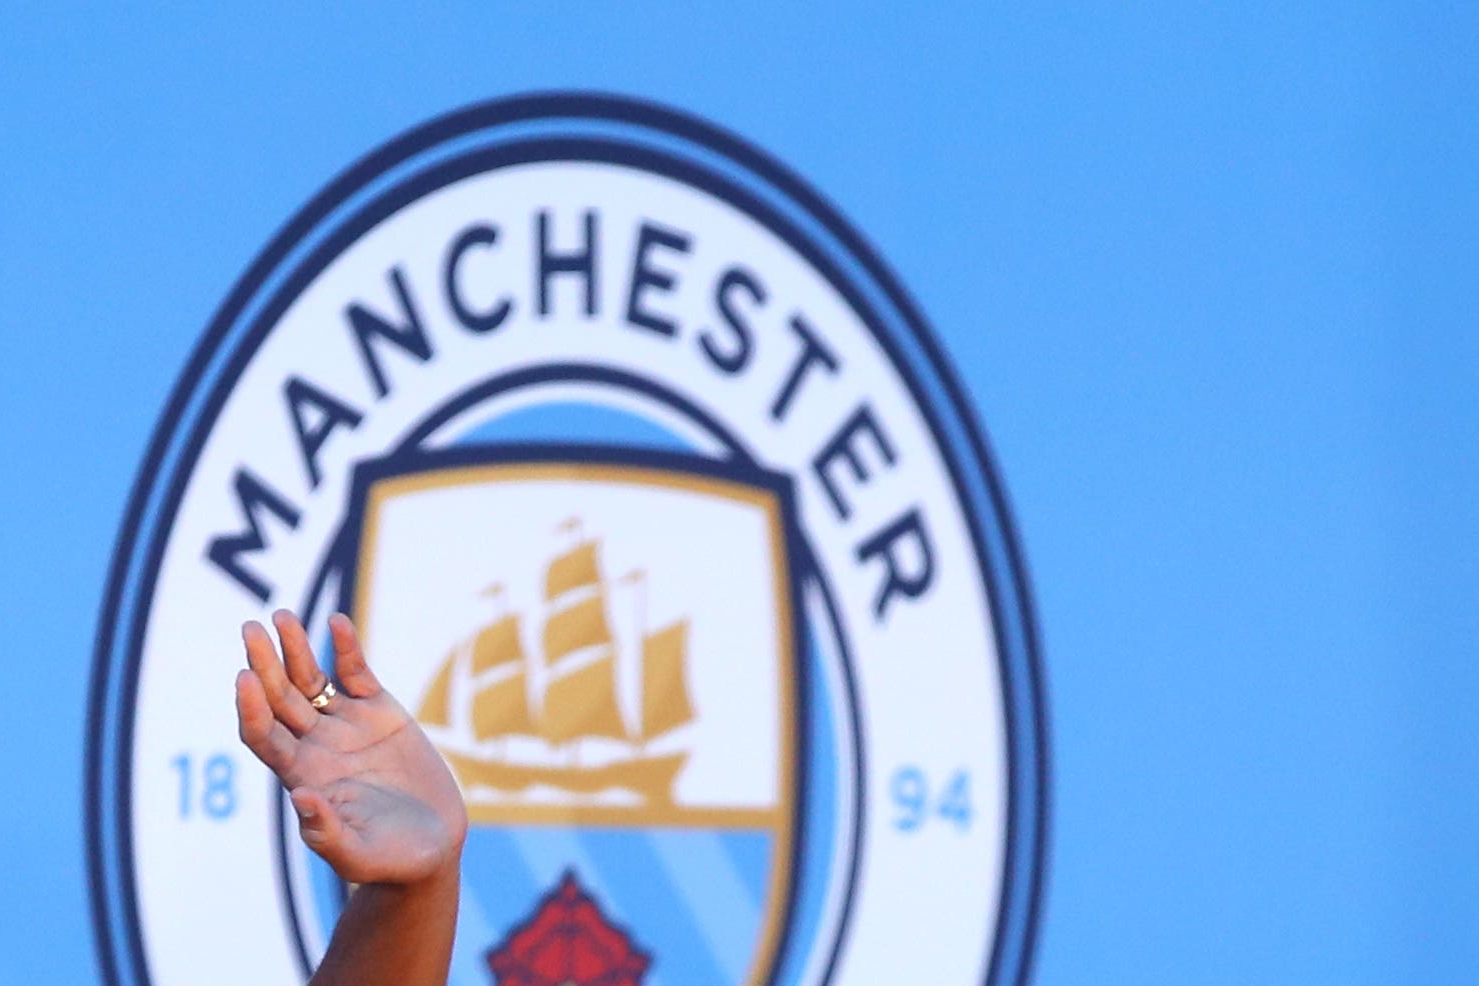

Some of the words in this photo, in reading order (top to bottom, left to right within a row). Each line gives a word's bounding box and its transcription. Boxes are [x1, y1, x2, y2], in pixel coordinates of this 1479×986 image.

[204, 210, 937, 620] MANCHESTER
[170, 752, 239, 821] 18
[890, 765, 975, 833] 94
